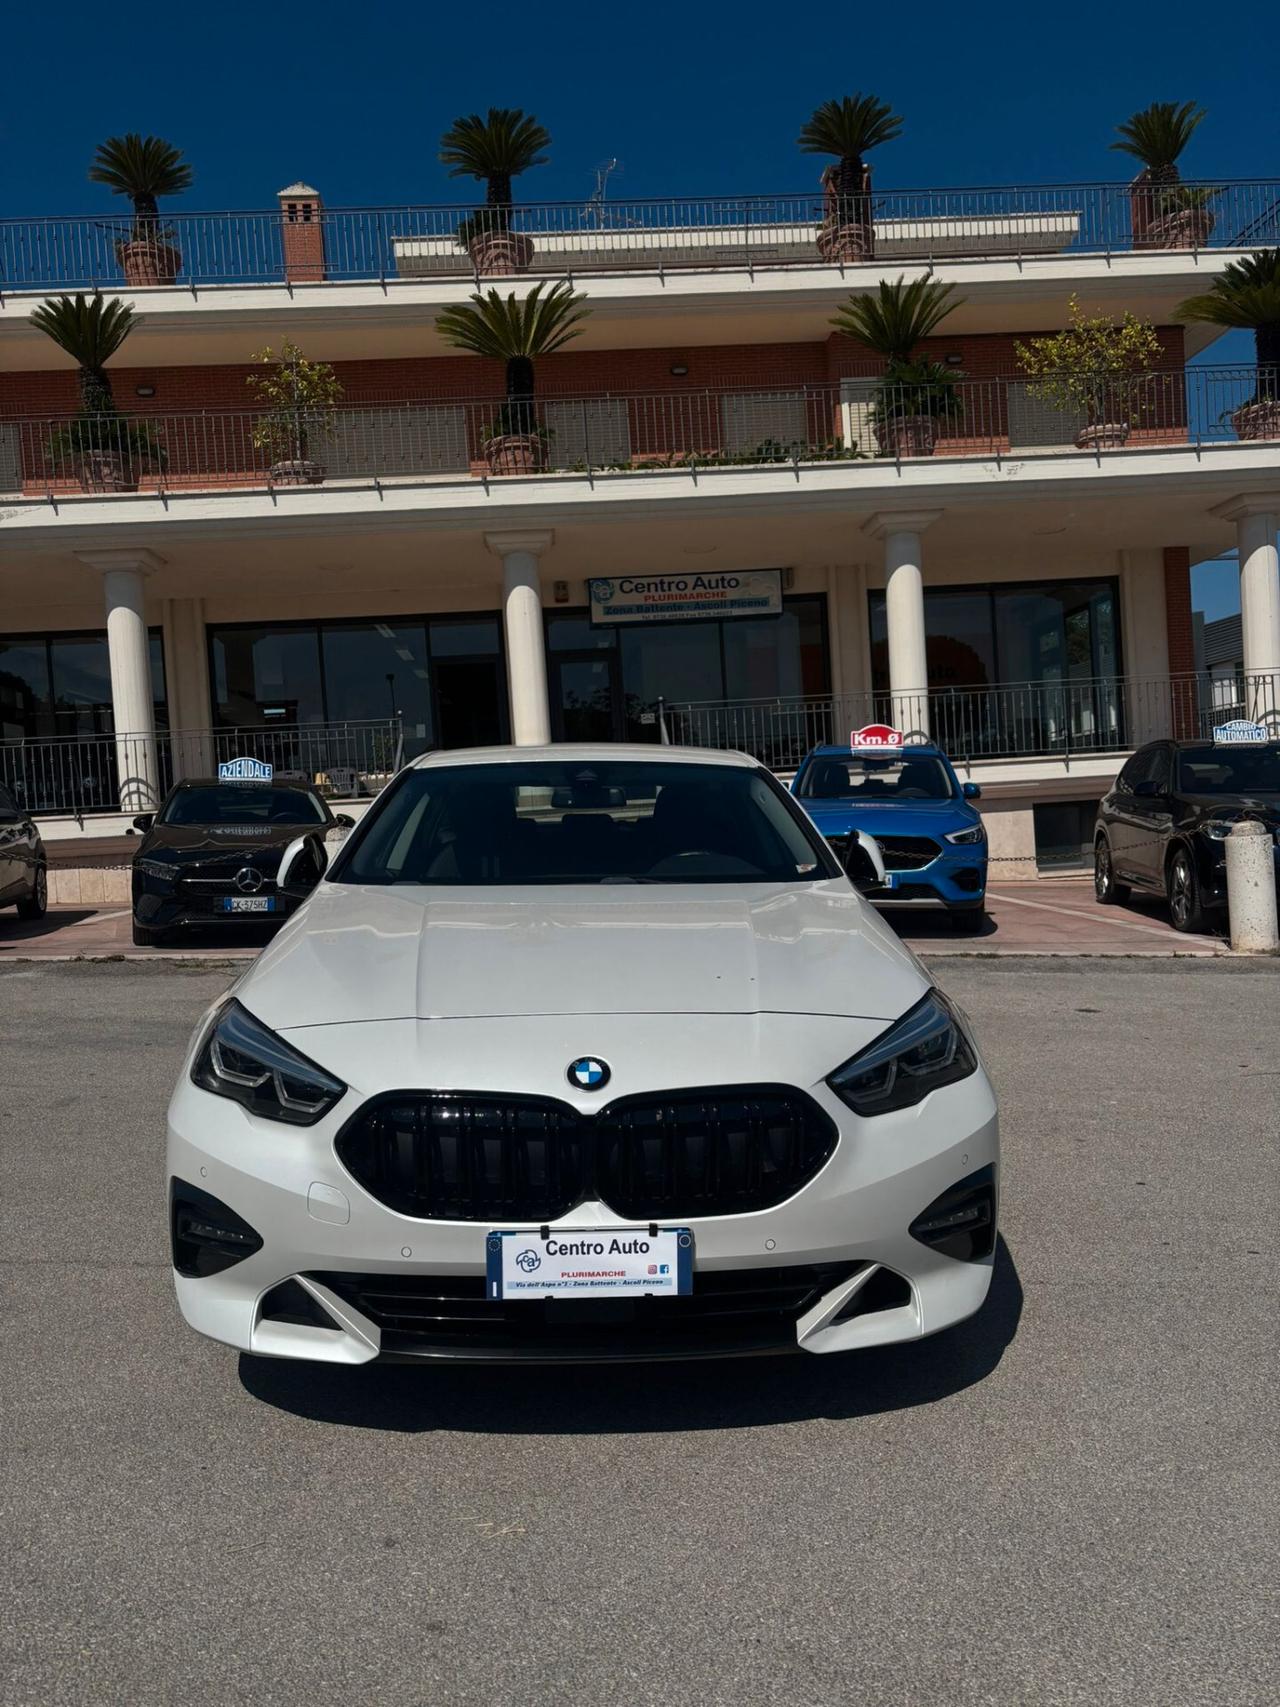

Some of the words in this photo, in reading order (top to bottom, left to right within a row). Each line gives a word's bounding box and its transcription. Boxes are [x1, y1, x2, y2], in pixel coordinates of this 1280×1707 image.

[620, 578, 688, 594] Centro
[692, 575, 740, 591] Auto
[643, 591, 728, 603] PLURIMARCHE
[606, 606, 634, 615] Zona
[637, 603, 684, 614] Battente
[694, 600, 727, 611] Ascoli
[731, 598, 769, 609] Piceno
[1216, 728, 1266, 741] AUTOMATICO
[1226, 722, 1256, 731] CAMBIO
[221, 759, 271, 778] AZIENDALE
[546, 1240, 604, 1256] Centro
[608, 1239, 650, 1254] Auto
